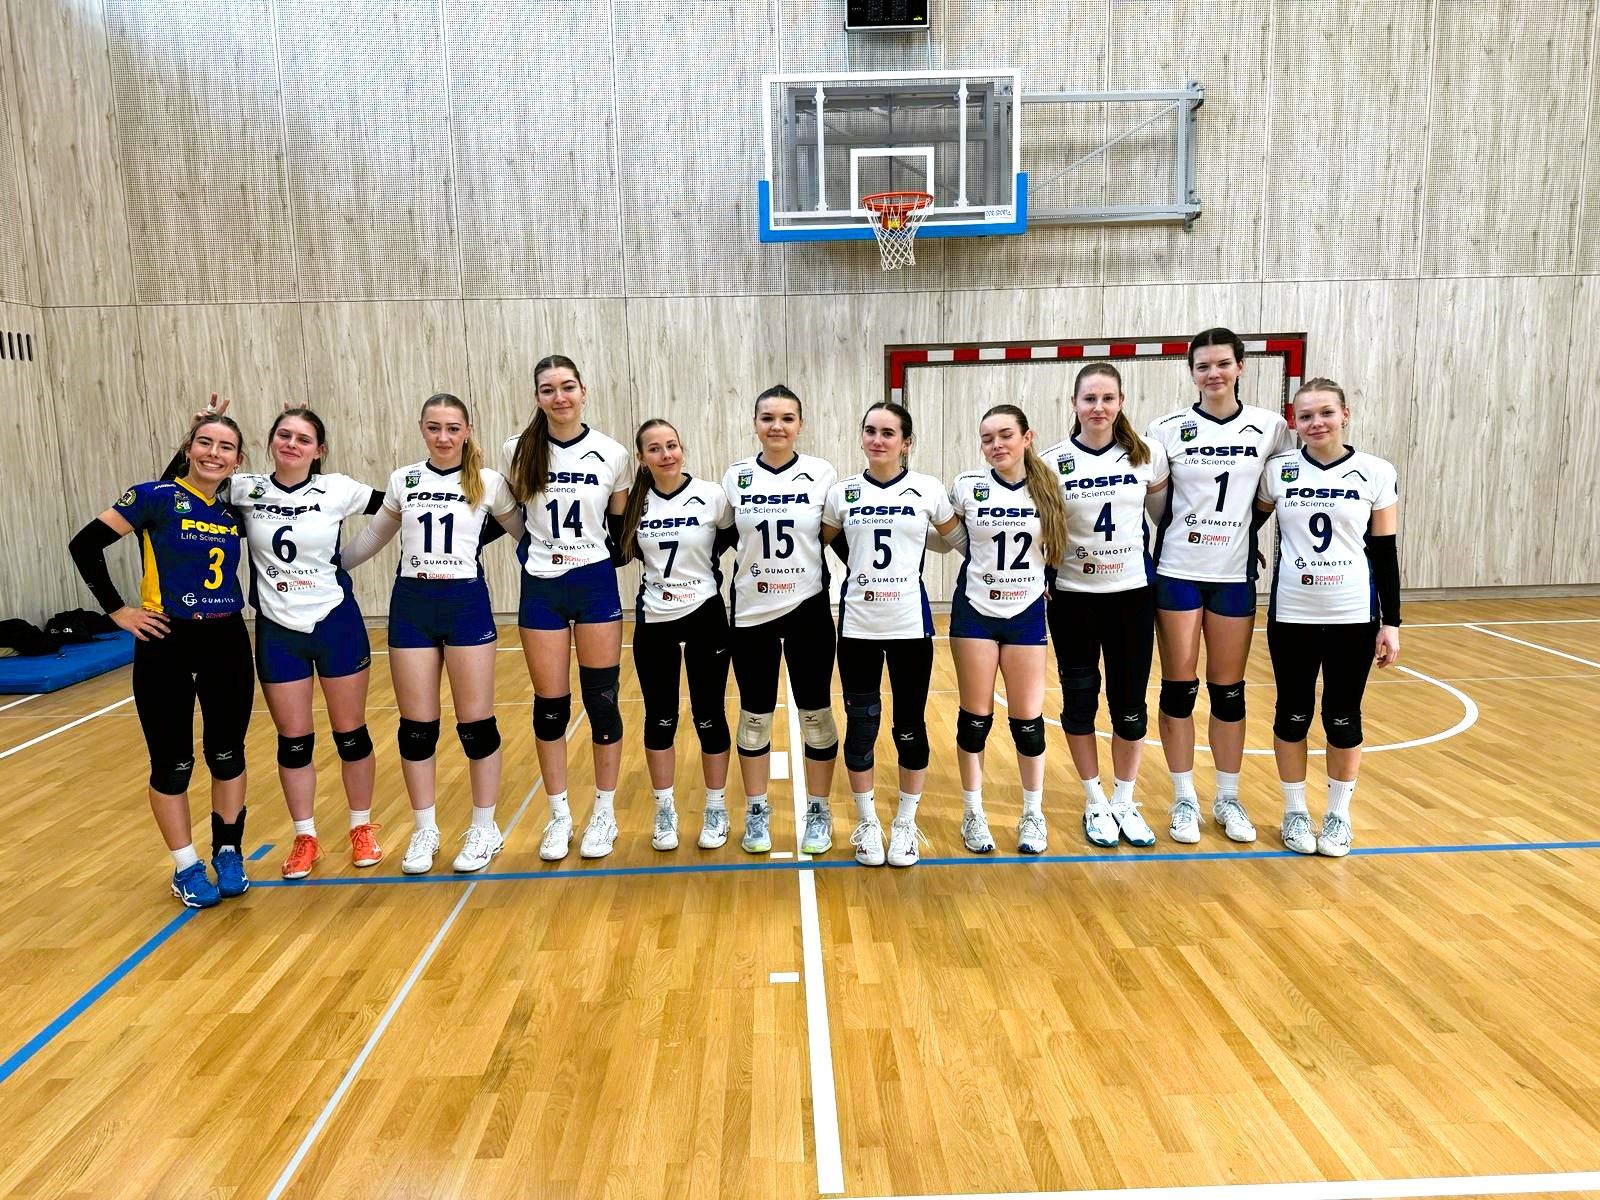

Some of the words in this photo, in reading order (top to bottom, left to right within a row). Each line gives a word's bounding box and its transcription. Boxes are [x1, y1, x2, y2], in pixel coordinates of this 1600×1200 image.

[1185, 446, 1258, 458] FOSFA
[1065, 474, 1138, 490] FOSFA
[1066, 492, 1079, 500] Life
[1082, 490, 1116, 498] Science
[1214, 470, 1230, 512] 1
[1286, 488, 1360, 500] FOSFA
[740, 493, 810, 506] FOSFA
[850, 506, 916, 517] FOSFA
[546, 499, 583, 538] 14
[640, 516, 700, 530] FOSFA
[1094, 502, 1116, 542] 4
[1202, 520, 1242, 528] GUMOTEX
[200, 534, 226, 543] Science
[272, 526, 297, 564] 6
[417, 512, 454, 554] 11
[755, 520, 794, 560] 15
[1202, 534, 1230, 542] SCHMIDT
[1309, 512, 1332, 554] 9
[659, 541, 679, 578] 7
[873, 529, 892, 570] 5
[992, 530, 1032, 570] 12
[1093, 547, 1132, 556] GUMOTEX
[204, 547, 225, 590] 3
